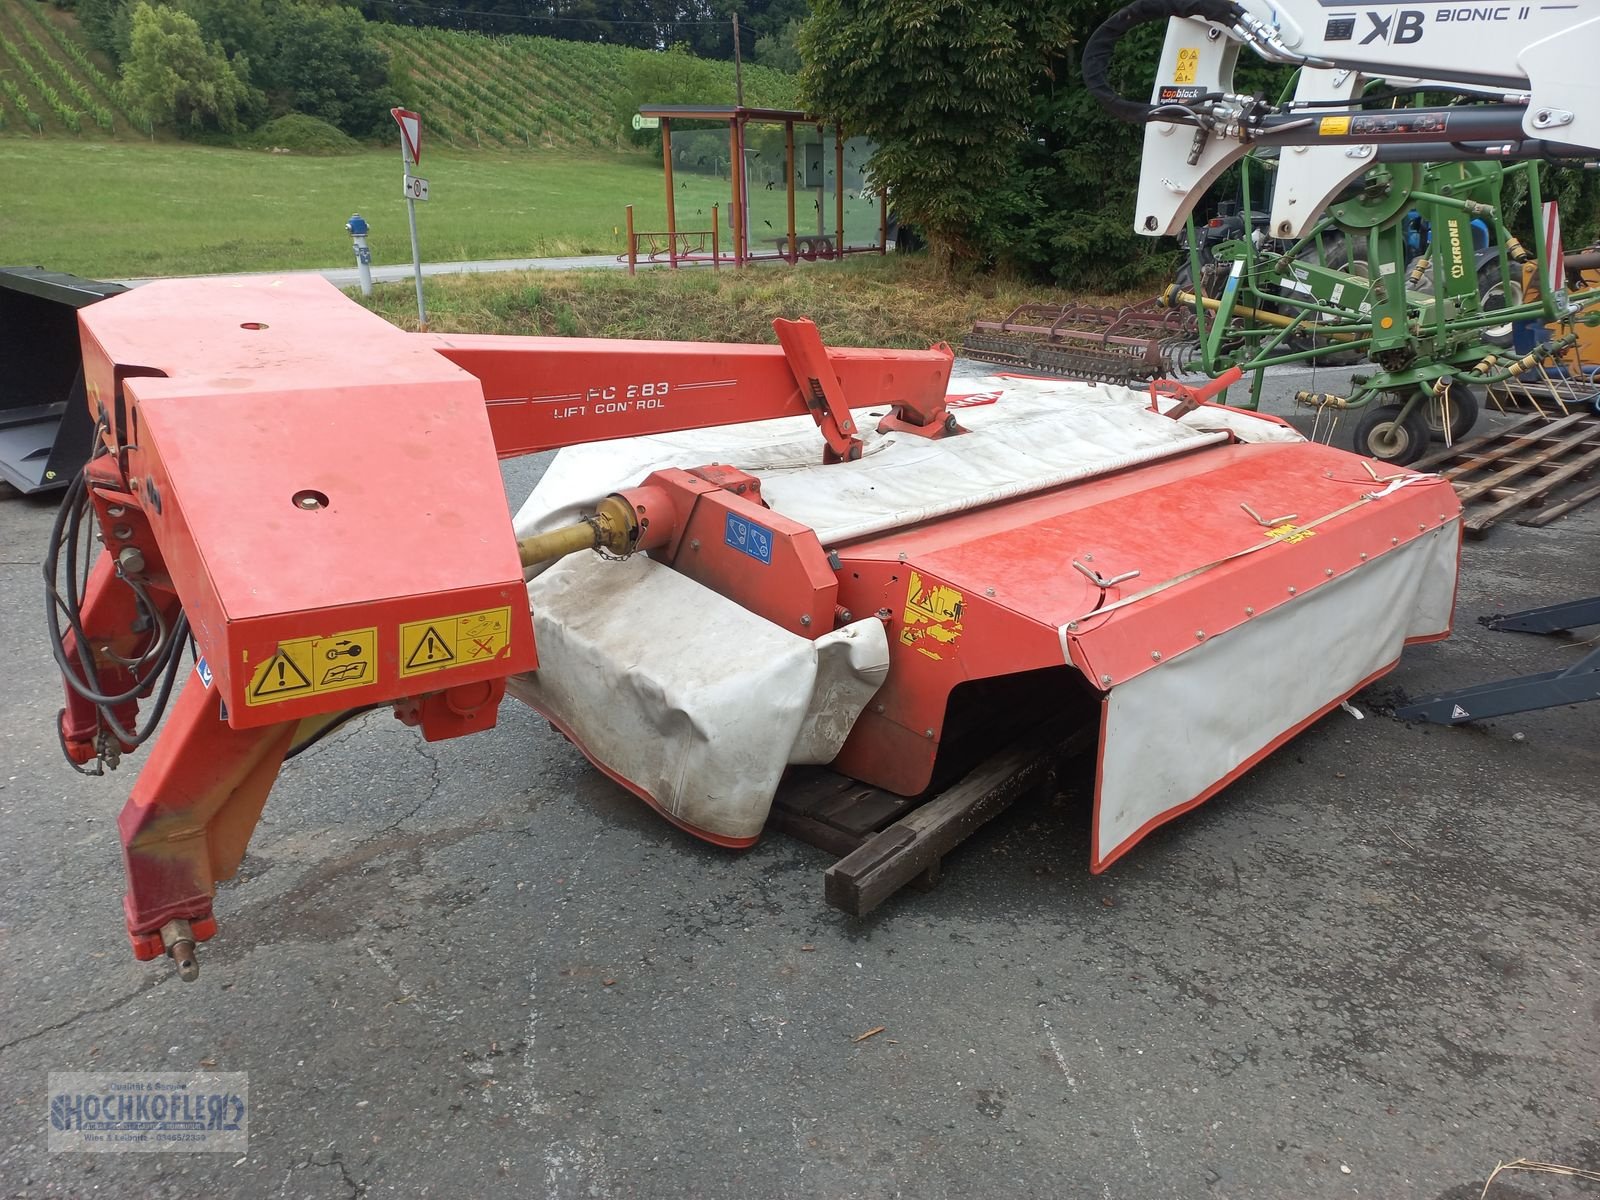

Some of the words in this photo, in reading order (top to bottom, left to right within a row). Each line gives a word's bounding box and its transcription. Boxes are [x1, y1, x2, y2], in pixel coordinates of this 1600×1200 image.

[1435, 7, 1510, 22] BIONIC
[1162, 89, 1199, 98] topblock
[1448, 219, 1463, 264] KRONE
[626, 382, 669, 398] 283
[554, 406, 586, 418] LIFT
